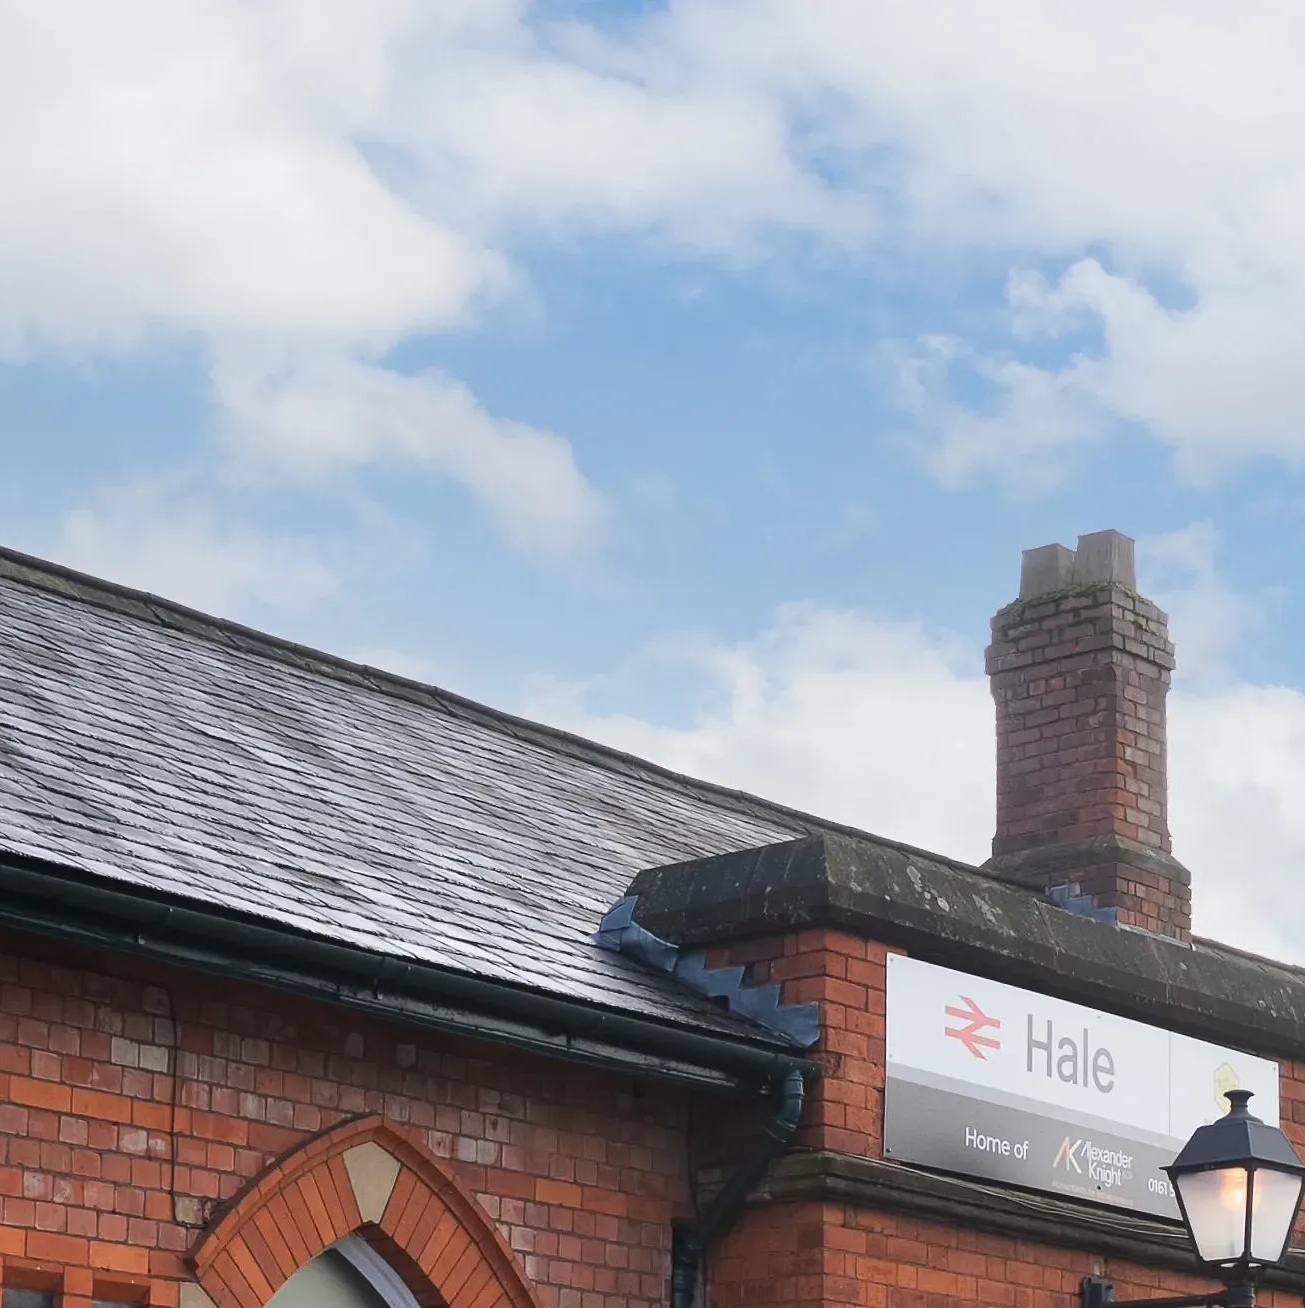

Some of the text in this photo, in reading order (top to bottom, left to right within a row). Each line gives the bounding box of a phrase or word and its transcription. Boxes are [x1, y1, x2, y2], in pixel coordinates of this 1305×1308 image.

[1027, 1013, 1115, 1094] Hale
[965, 1127, 1030, 1160] Home of
[1081, 1141, 1133, 1170] Alexander
[1088, 1161, 1122, 1187] Knight
[1147, 1178, 1168, 1197] 0161
